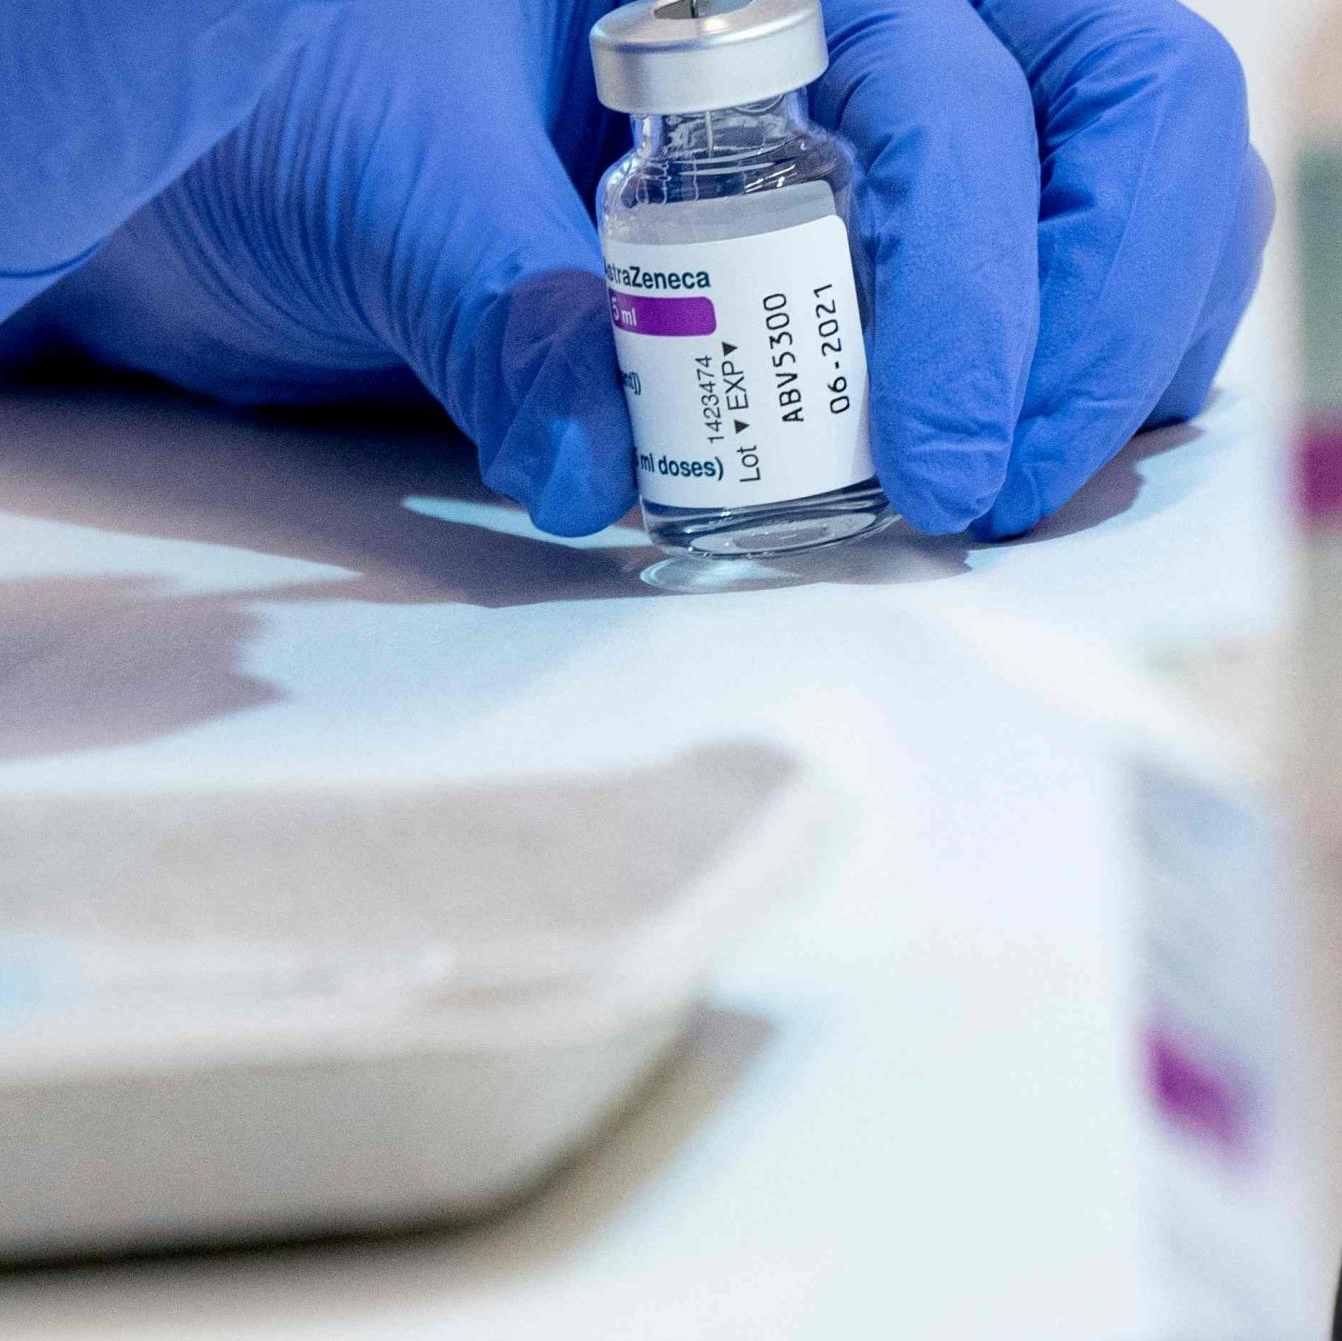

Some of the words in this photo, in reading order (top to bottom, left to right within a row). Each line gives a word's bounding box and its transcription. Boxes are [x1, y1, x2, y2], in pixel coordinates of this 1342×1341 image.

[621, 307, 637, 327] ml
[762, 292, 805, 423] ABV5300
[695, 355, 724, 444] 1423474
[721, 360, 749, 411] EXP
[640, 452, 655, 473] ml
[658, 454, 724, 481] doses)
[736, 445, 761, 482] Lot
